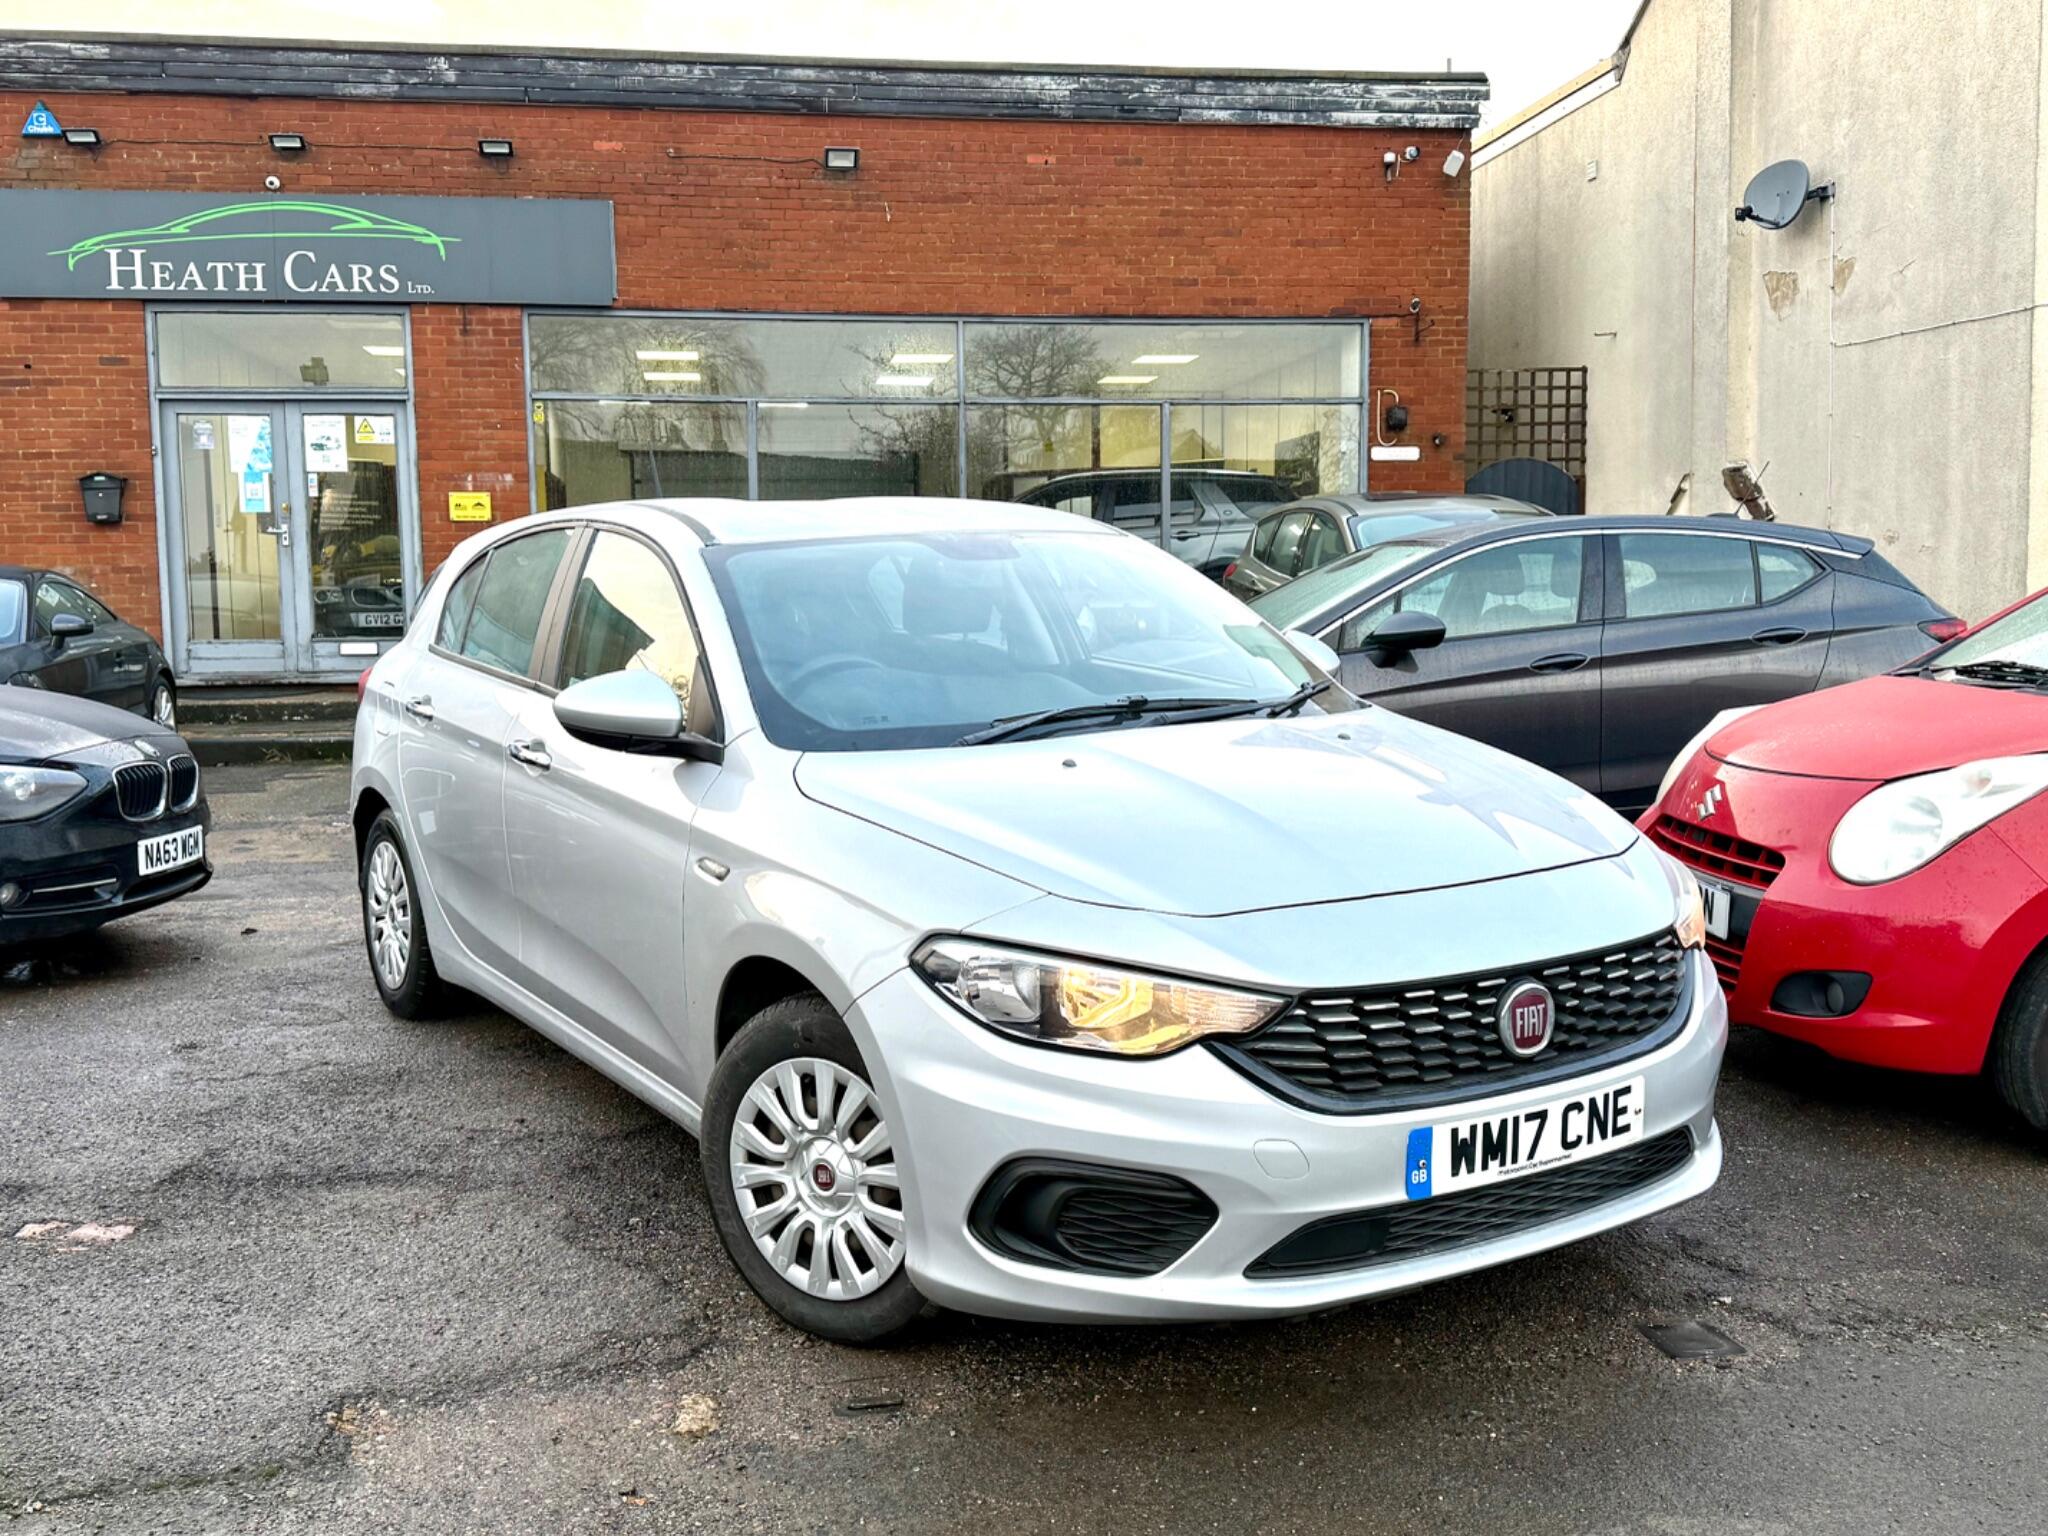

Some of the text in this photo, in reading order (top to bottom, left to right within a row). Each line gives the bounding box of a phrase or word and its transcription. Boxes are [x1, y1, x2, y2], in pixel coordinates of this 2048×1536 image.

[104, 248, 268, 292] HEATH
[283, 250, 400, 293] CARS
[144, 831, 200, 870] NA63 WGM
[1515, 1003, 1546, 1039] FIAT
[1451, 1085, 1632, 1177] WM17 CNE
[1411, 1169, 1428, 1184] GB
